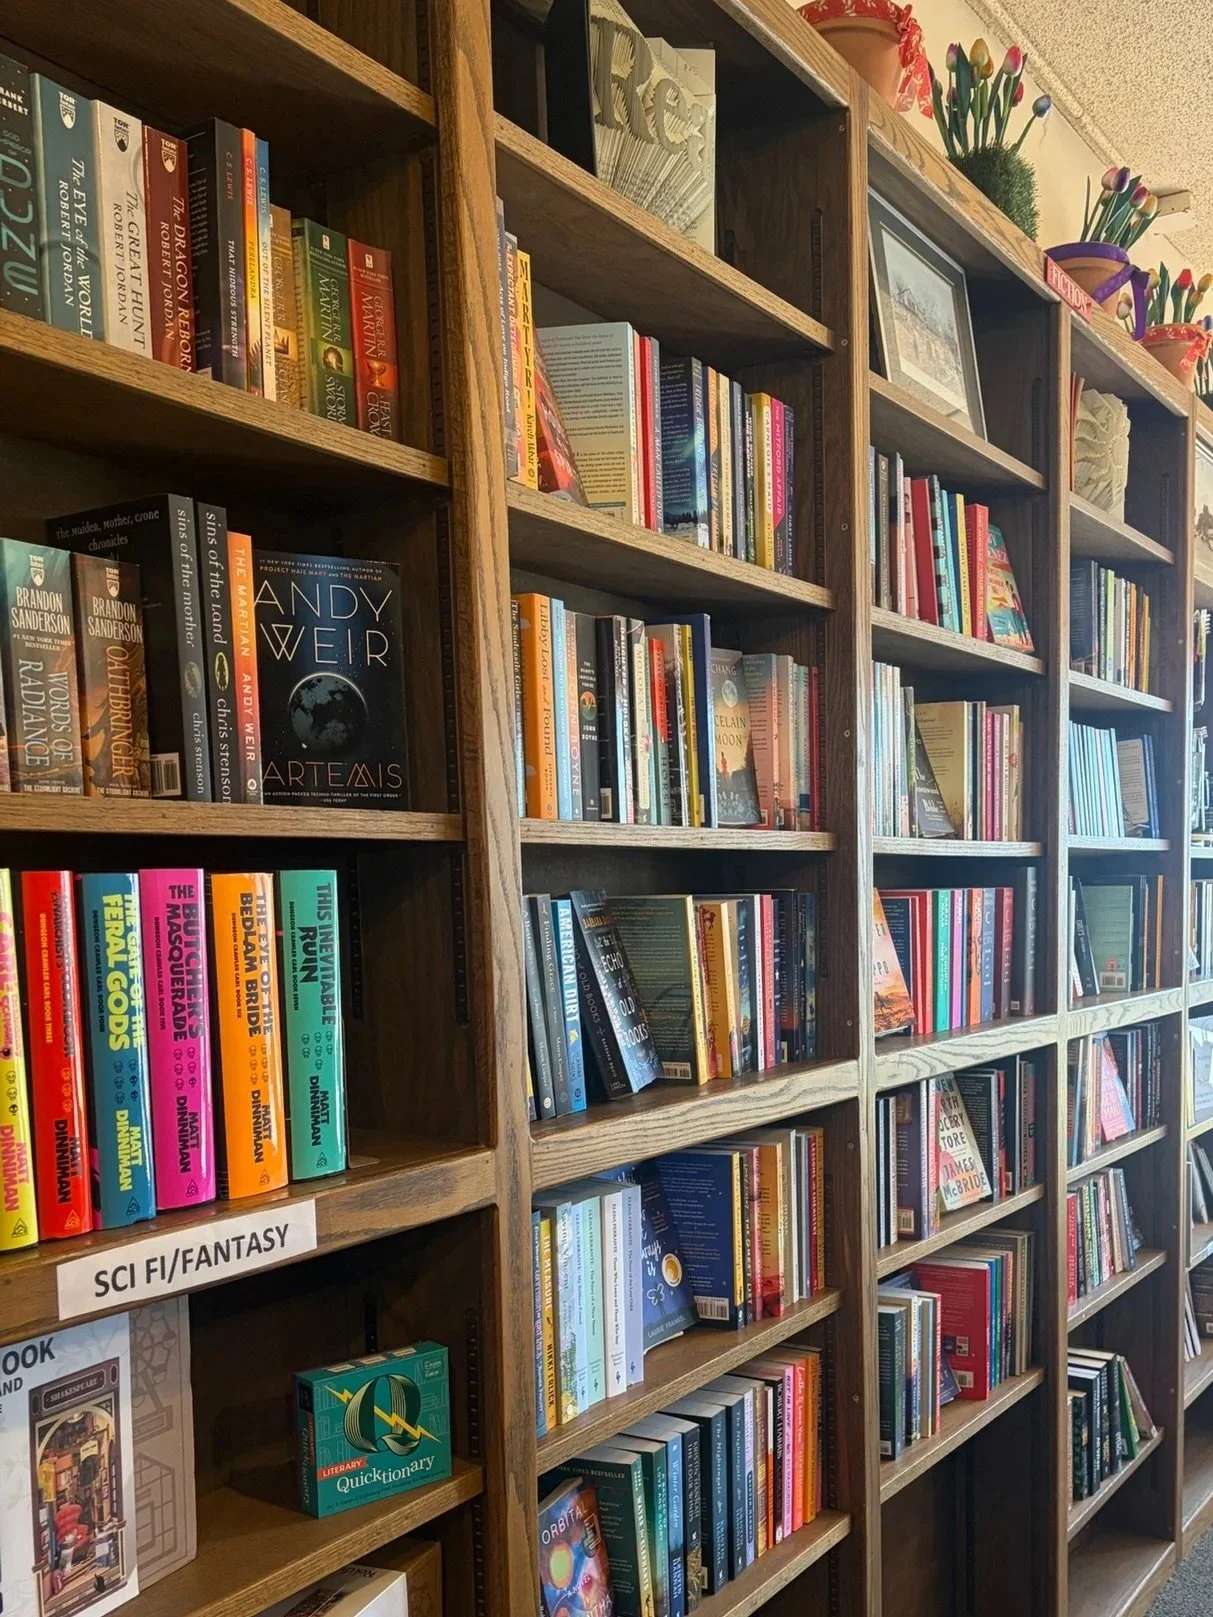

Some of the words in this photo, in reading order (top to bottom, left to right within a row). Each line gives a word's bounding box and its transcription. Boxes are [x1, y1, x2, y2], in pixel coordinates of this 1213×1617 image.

[0, 97, 29, 116] RBERT
[58, 91, 77, 105] TOR
[113, 117, 130, 129] TOR
[161, 138, 177, 150] TOR
[71, 157, 85, 186] The
[58, 179, 72, 240] ROBERT
[73, 189, 87, 226] EYE
[125, 191, 138, 217] The
[172, 196, 185, 221] The
[75, 228, 88, 250] of
[112, 202, 125, 261] ROBERT
[160, 221, 172, 280] ROBERT
[228, 239, 236, 258] THAT
[76, 249, 89, 270] the
[127, 220, 143, 287] GREAT
[173, 224, 189, 306] DRAGON
[61, 243, 75, 307] JORDAN
[114, 264, 129, 326] JORDAN
[229, 260, 238, 307] HIDEOUS
[1052, 264, 1088, 315] FICTION
[130, 289, 146, 349] HUNT
[161, 280, 175, 341] JORDAN
[318, 273, 333, 343] MARTIN
[361, 291, 377, 358] MARTIN
[231, 309, 241, 359] STRENGTH
[265, 327, 273, 367] PLANET
[519, 258, 533, 409] MARTYR!
[177, 508, 188, 539] sins
[205, 511, 217, 545] sins
[180, 561, 192, 588] the
[235, 547, 246, 578] THE
[16, 586, 63, 613] BRANDON
[209, 569, 221, 600] the
[253, 580, 393, 622] ANDY
[11, 607, 71, 636] SANDERSON
[92, 596, 137, 622] BRANDON
[182, 591, 195, 648] mother
[237, 586, 250, 658] MARTIAN
[540, 604, 549, 647] Libby
[88, 616, 144, 644] SANDERSON
[260, 622, 389, 667] WEIR
[541, 648, 550, 681] Lost
[711, 663, 737, 676] CHANG
[18, 658, 50, 768] RADIANCE
[48, 671, 71, 733] WORDS
[105, 644, 135, 779] OATHBRINGER
[216, 697, 231, 734] chris
[241, 673, 253, 720] ANDY
[193, 711, 203, 743] chris
[243, 723, 256, 762] WEIR
[543, 706, 554, 756] Found
[52, 737, 74, 762] OF
[262, 760, 404, 789] ARTEMIS
[661, 757, 670, 809] HORSE
[169, 885, 194, 899] THE
[256, 894, 268, 927] THE
[316, 882, 331, 921] THIS
[102, 894, 128, 968] FERAL
[240, 893, 258, 973] BEDLAM
[258, 933, 270, 965] EYE
[559, 908, 578, 986] AMERICAN
[166, 903, 187, 1042] MASQUERADE
[182, 903, 205, 1040] BUTCHER'S
[297, 926, 319, 983] RUIN
[318, 923, 337, 1026] INEVITABLE
[600, 954, 625, 974] ECHO
[260, 971, 271, 996] OF
[579, 971, 590, 992] OLD
[586, 992, 602, 1025] BOOKS
[106, 971, 130, 1051] GODS
[245, 978, 261, 1038] BRIDE
[263, 1003, 274, 1036] THE
[564, 988, 580, 1023] DIRT
[618, 996, 636, 1018] OLD
[624, 1023, 649, 1049] BOOKS
[250, 1089, 264, 1164] DINNIMAN
[261, 1104, 272, 1141] MATT
[309, 1075, 323, 1147] DINNIMAN
[319, 1090, 330, 1126] MATT
[115, 1109, 133, 1192] DINNIMAN
[129, 1125, 143, 1167] MATT
[175, 1095, 191, 1174] DINNIMAN
[188, 1112, 199, 1151] MATT
[0, 1124, 20, 1213] DINNIMAN
[16, 1142, 28, 1184] MATT
[55, 1119, 72, 1204] DINNIMAN
[69, 1136, 82, 1177] MATT
[943, 1157, 975, 1181] JAMES
[943, 1172, 987, 1201] McBRIDE
[94, 1264, 137, 1299] SCI
[145, 1223, 290, 1285] FI/FANTASY
[544, 1258, 553, 1310] MEASURE
[50, 1379, 98, 1402] SHAKESPEARE
[322, 1459, 363, 1478] LITERARY
[336, 1455, 435, 1494] Quicktionary
[672, 1461, 680, 1492] Winter
[541, 1500, 589, 1545] ORBITAL
